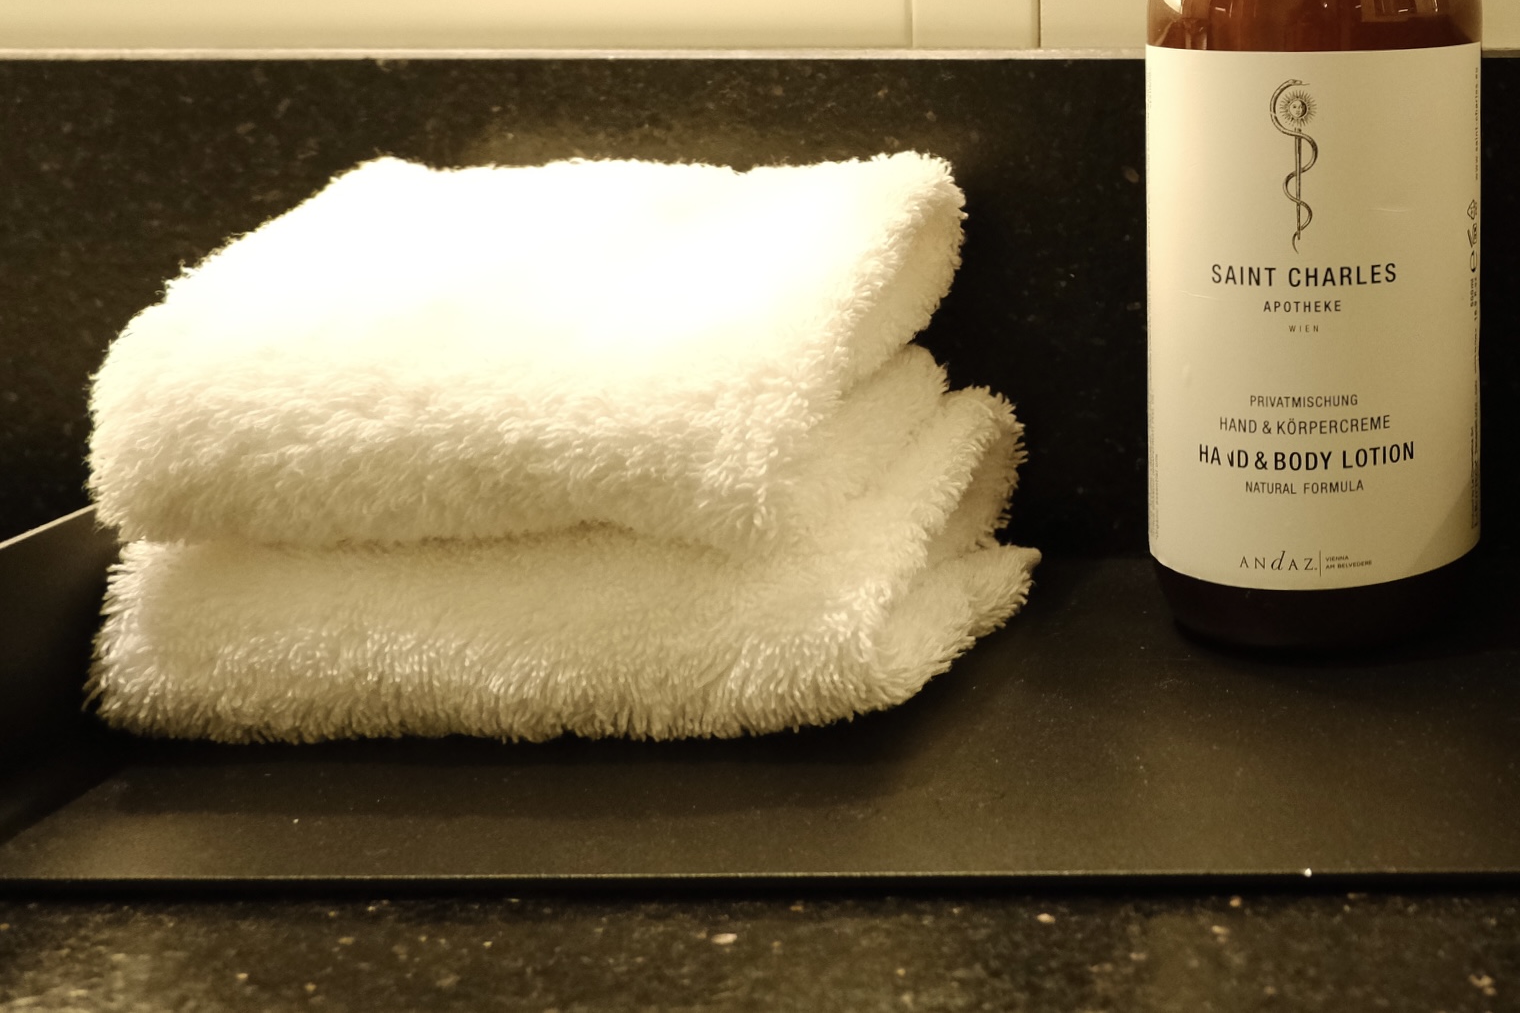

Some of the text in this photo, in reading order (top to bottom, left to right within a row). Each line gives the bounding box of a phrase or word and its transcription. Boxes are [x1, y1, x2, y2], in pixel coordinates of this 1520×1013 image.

[1211, 262, 1397, 288] SAINT CHARLES
[1263, 299, 1342, 313] APOTHEKE
[1288, 324, 1320, 333] WIEN
[1249, 394, 1359, 408] PRIVATMISCHUNG
[1219, 414, 1391, 436] HAND & KÖRPERCREME
[1253, 450, 1269, 471] &
[1273, 450, 1333, 472] BODY
[1342, 440, 1415, 469] LOTION
[1245, 479, 1365, 495] NATURAL FORMULA
[1325, 555, 1350, 563] VIENNA
[1337, 559, 1373, 569] BELVEDERE
